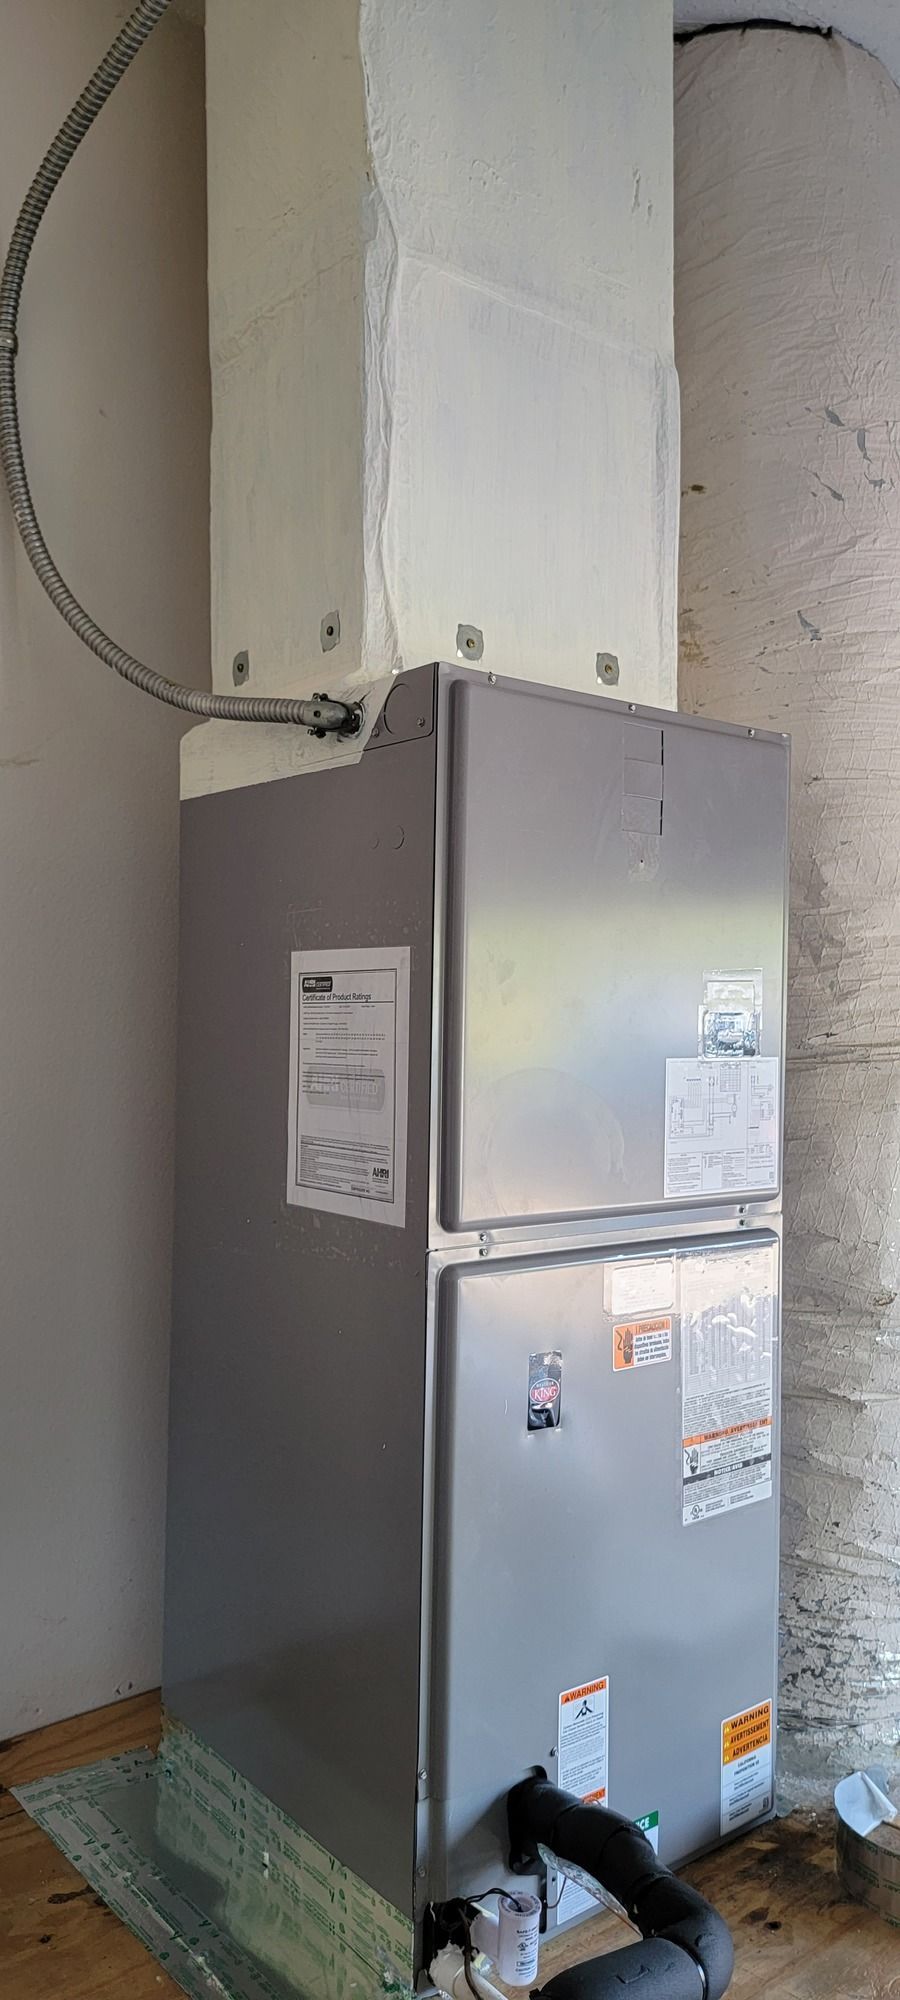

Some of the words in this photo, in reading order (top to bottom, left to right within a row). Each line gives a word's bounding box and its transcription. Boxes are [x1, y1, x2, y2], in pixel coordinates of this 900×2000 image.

[302, 993, 326, 1002] Certificate
[326, 993, 332, 1001] of
[332, 992, 352, 1001] Product
[352, 992, 372, 1003] Ratings
[372, 1167, 390, 1179] AHRI
[533, 1386, 557, 1400] KING
[568, 1681, 605, 1701] WARNING
[730, 1705, 769, 1730] WARNING
[730, 1718, 769, 1744] AVERTISSEMENT
[732, 1733, 768, 1757] ADVERTENCIA
